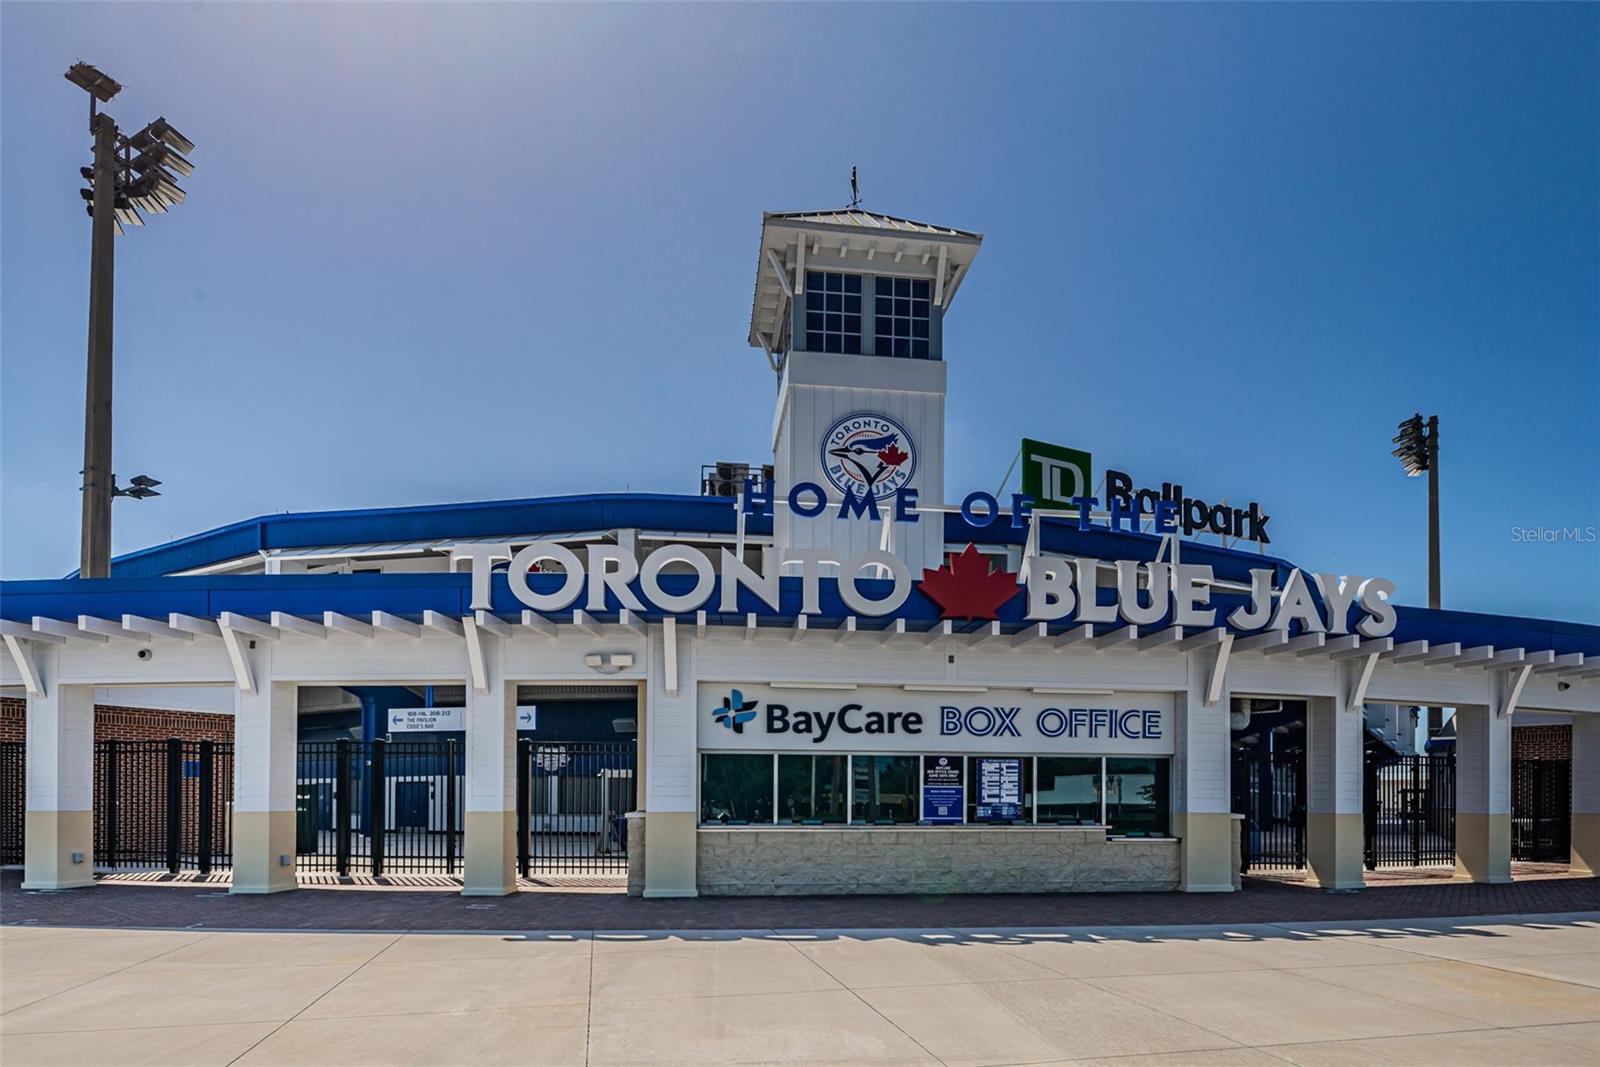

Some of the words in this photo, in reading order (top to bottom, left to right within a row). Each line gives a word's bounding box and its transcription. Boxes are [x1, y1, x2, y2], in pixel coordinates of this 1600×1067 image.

[830, 419, 890, 446] TORONTO
[829, 464, 866, 495] BLUE
[872, 469, 908, 496] JAYS
[1030, 453, 1085, 503] TD
[1106, 469, 1271, 544] Ballpark
[743, 479, 921, 523] HOME
[959, 491, 1034, 529] OF
[1072, 496, 1179, 534] THE
[452, 542, 912, 616] TORONTO
[1023, 555, 1218, 627] BLUE
[1227, 567, 1398, 638] JAYS
[765, 703, 923, 743] BayCare
[940, 706, 1022, 739] BOX
[1036, 707, 1162, 740] OFFICE
